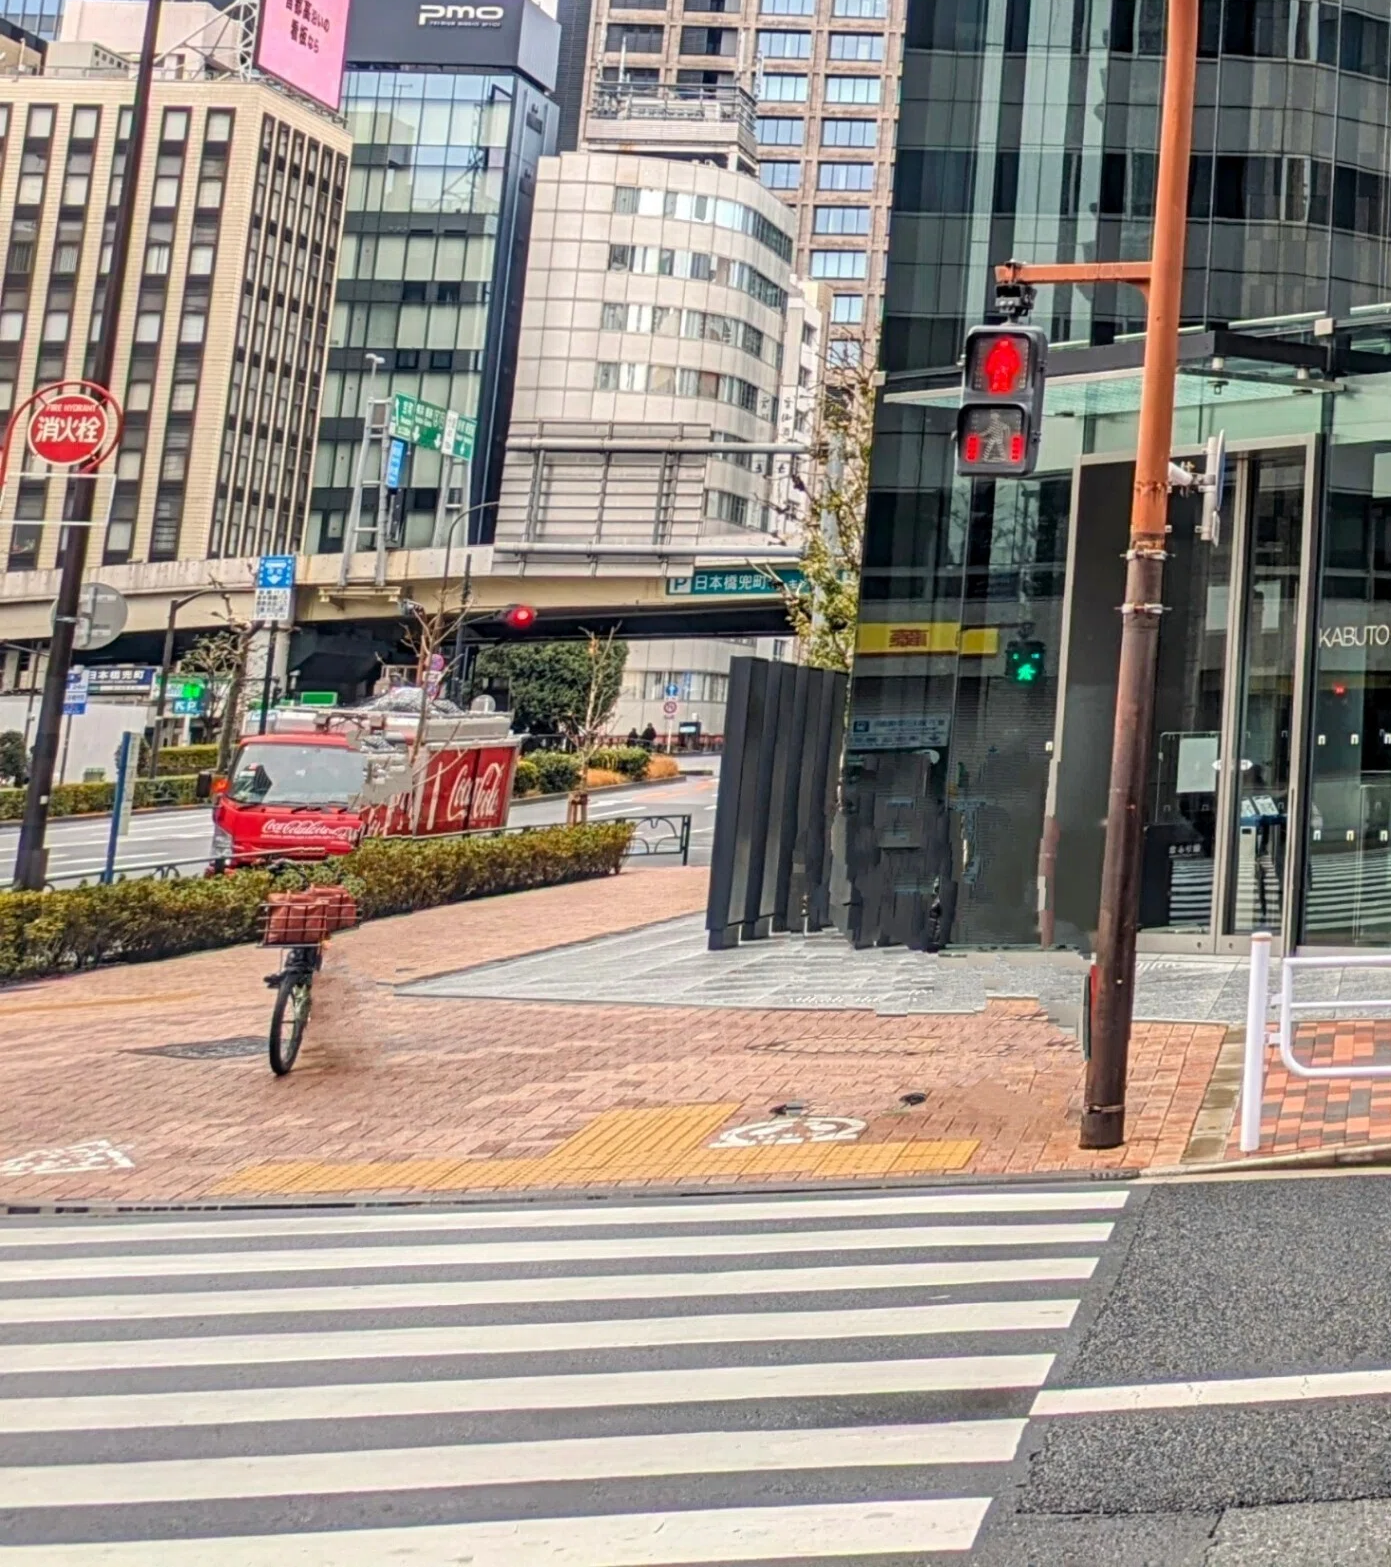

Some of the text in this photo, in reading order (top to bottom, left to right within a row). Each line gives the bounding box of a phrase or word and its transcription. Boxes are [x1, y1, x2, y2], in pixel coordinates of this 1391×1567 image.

[35, 416, 101, 443] 消火栓
[1318, 624, 1390, 648] KABUTO
